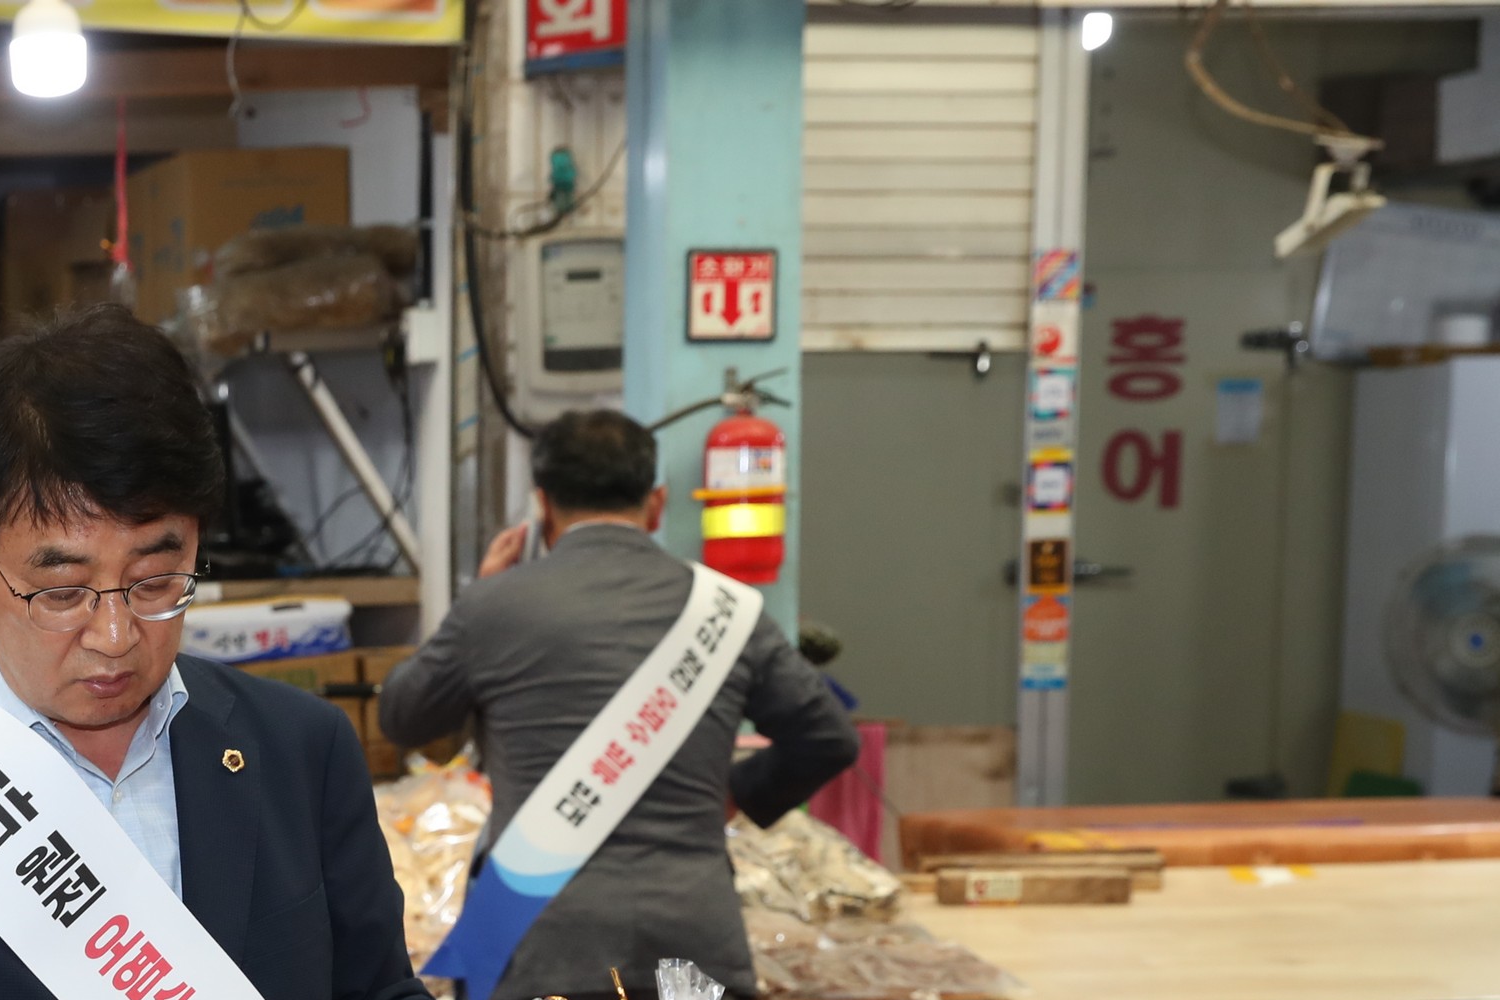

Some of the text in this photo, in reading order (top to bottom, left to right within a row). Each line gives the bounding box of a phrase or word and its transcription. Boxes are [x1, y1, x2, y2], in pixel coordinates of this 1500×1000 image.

[1102, 315, 1186, 510] 홍어
[554, 779, 603, 828] 반대
[15, 830, 108, 929] 원전
